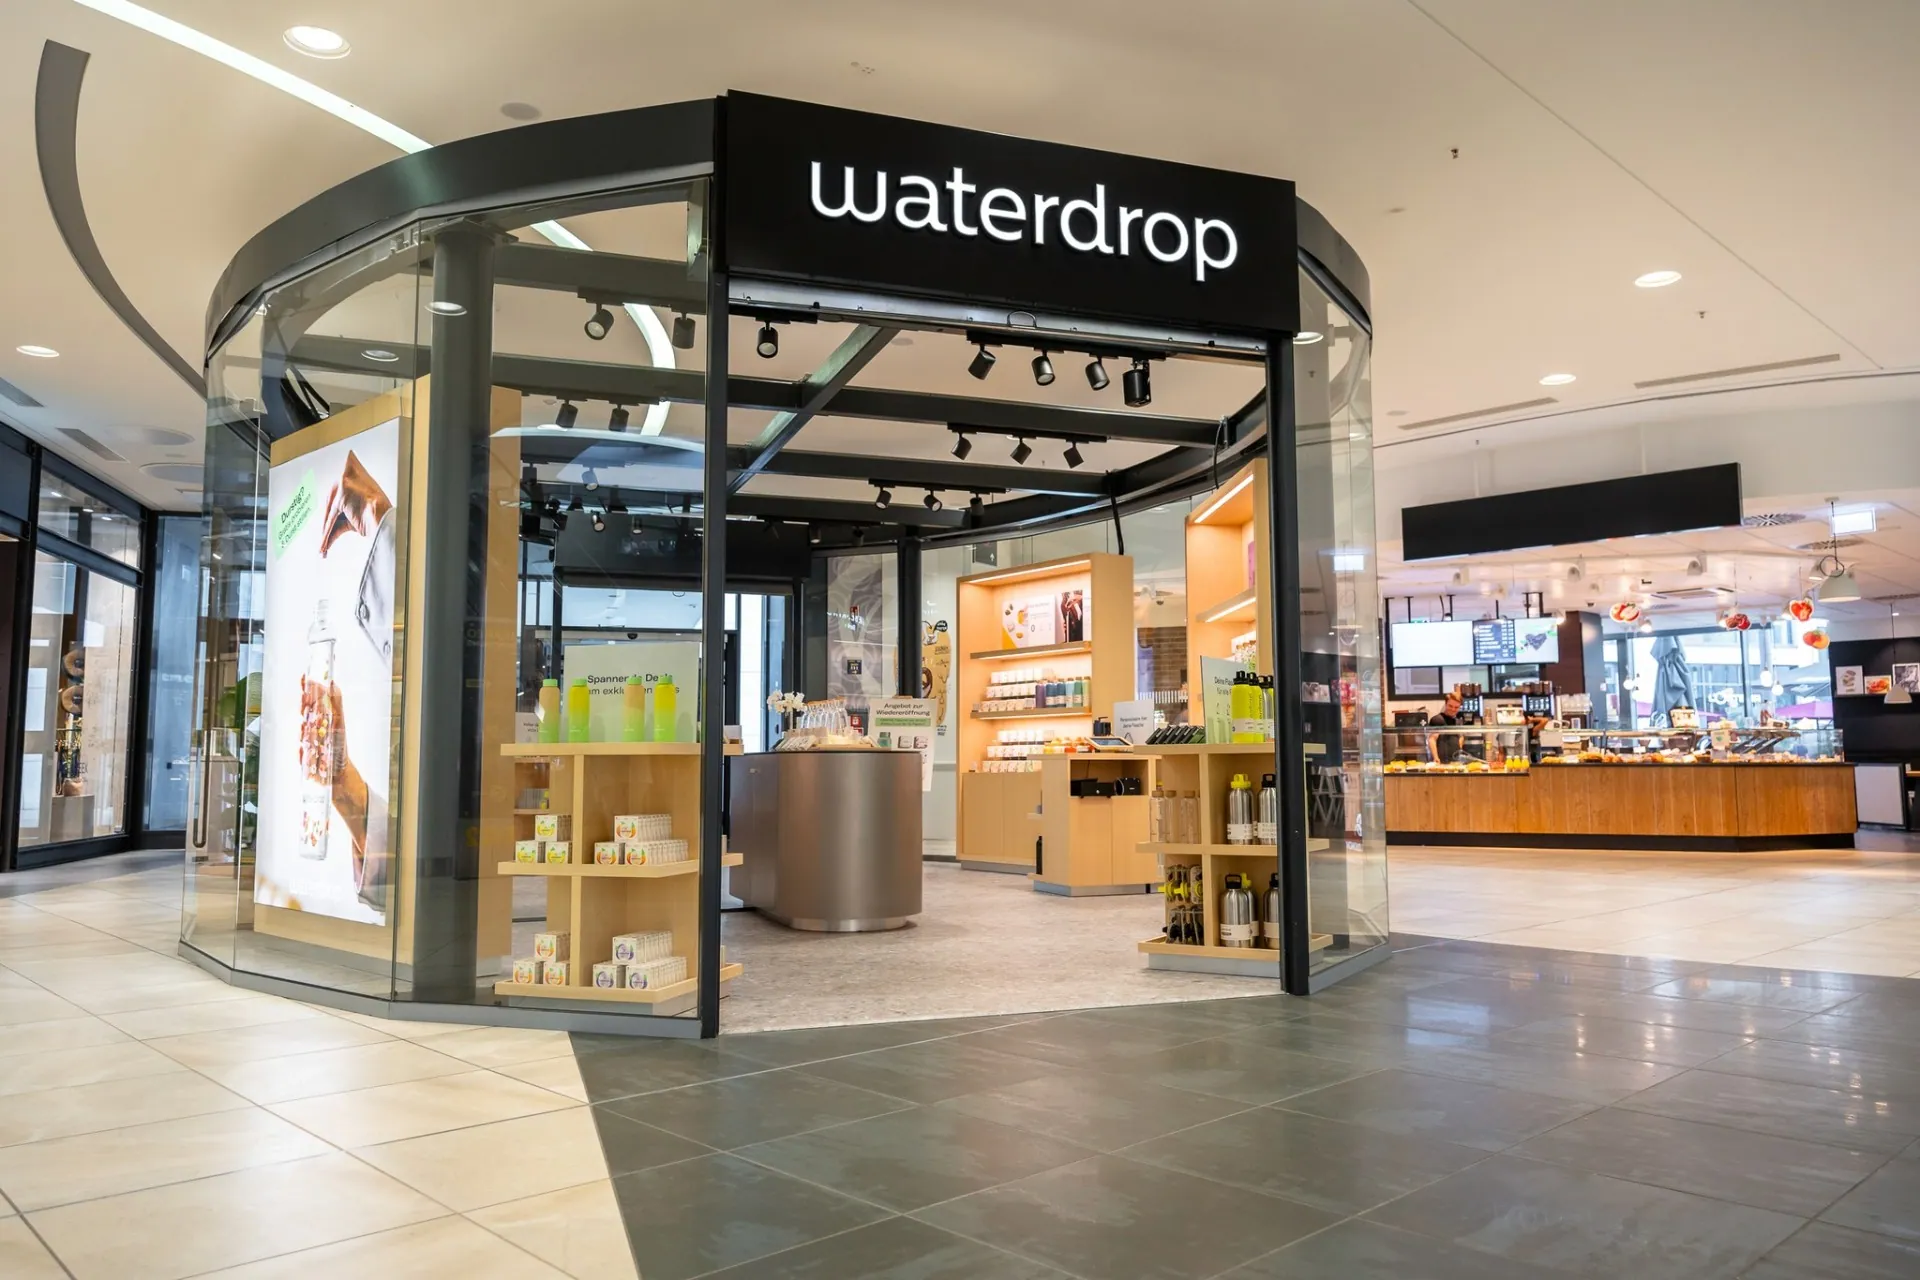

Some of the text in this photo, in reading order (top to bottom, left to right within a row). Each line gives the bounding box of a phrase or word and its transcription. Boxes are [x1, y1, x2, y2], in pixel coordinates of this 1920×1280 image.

[811, 161, 1239, 282] waterdrop
[281, 486, 304, 523] Durstig?
[587, 673, 642, 684] Spannen
